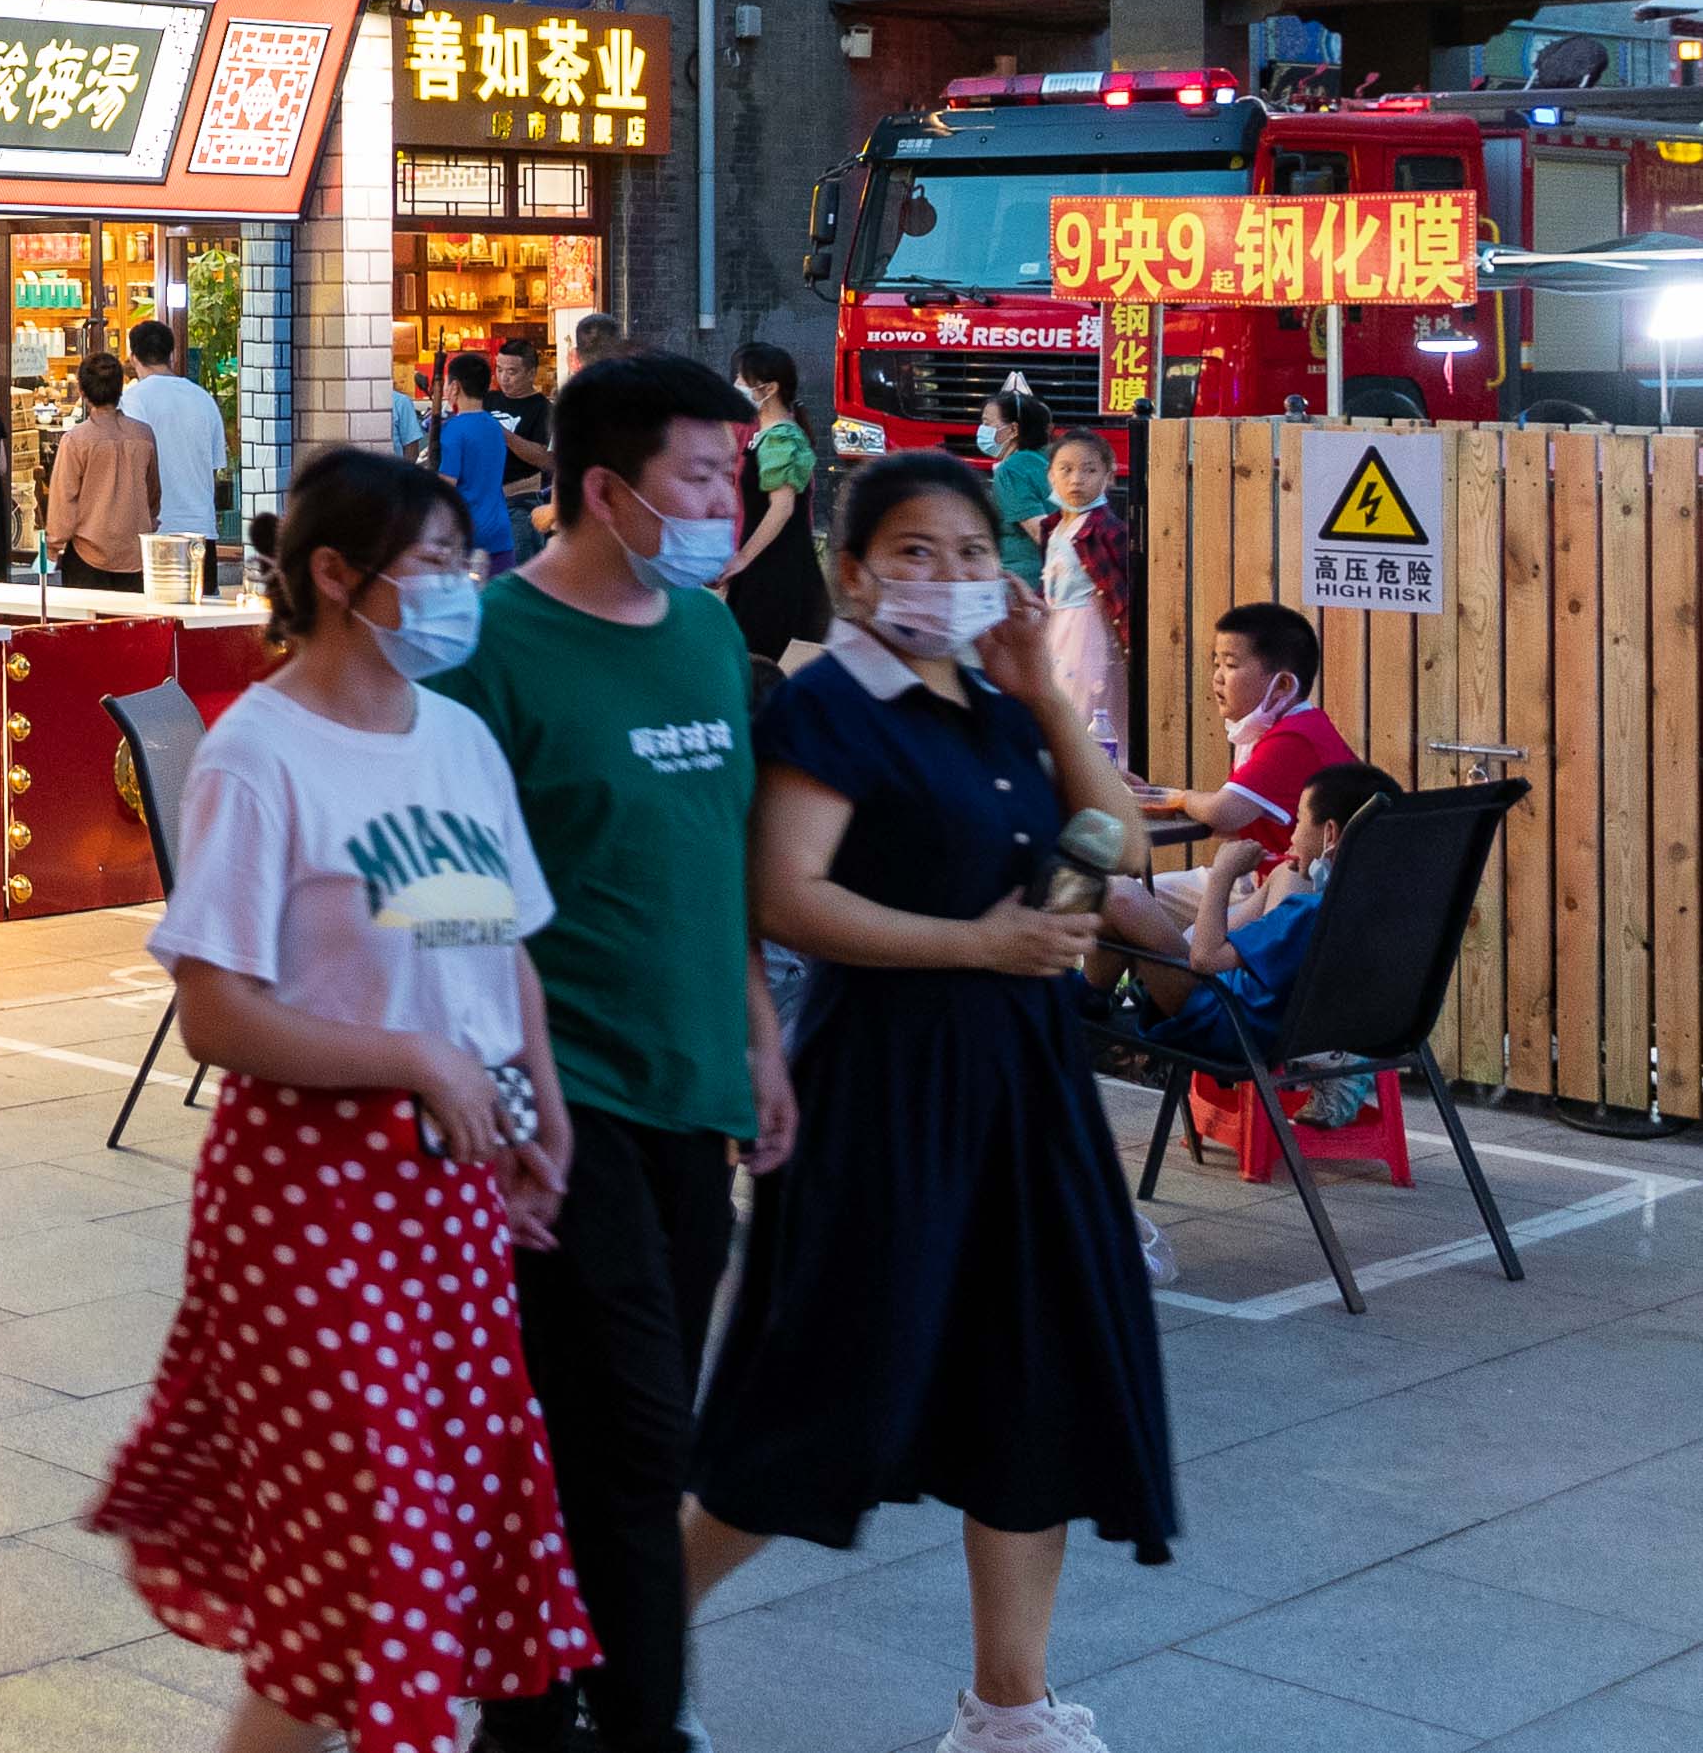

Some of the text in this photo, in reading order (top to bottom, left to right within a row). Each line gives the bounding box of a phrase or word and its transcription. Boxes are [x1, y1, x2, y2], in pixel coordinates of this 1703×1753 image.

[407, 11, 648, 111] 善如茶业
[866, 330, 927, 343] HOWO
[937, 313, 971, 346] 救
[972, 326, 1072, 348] RESCUE
[1107, 304, 1150, 412] 钢化膜
[1314, 555, 1433, 587] 高压危险
[1316, 582, 1433, 604] HIGH RISK
